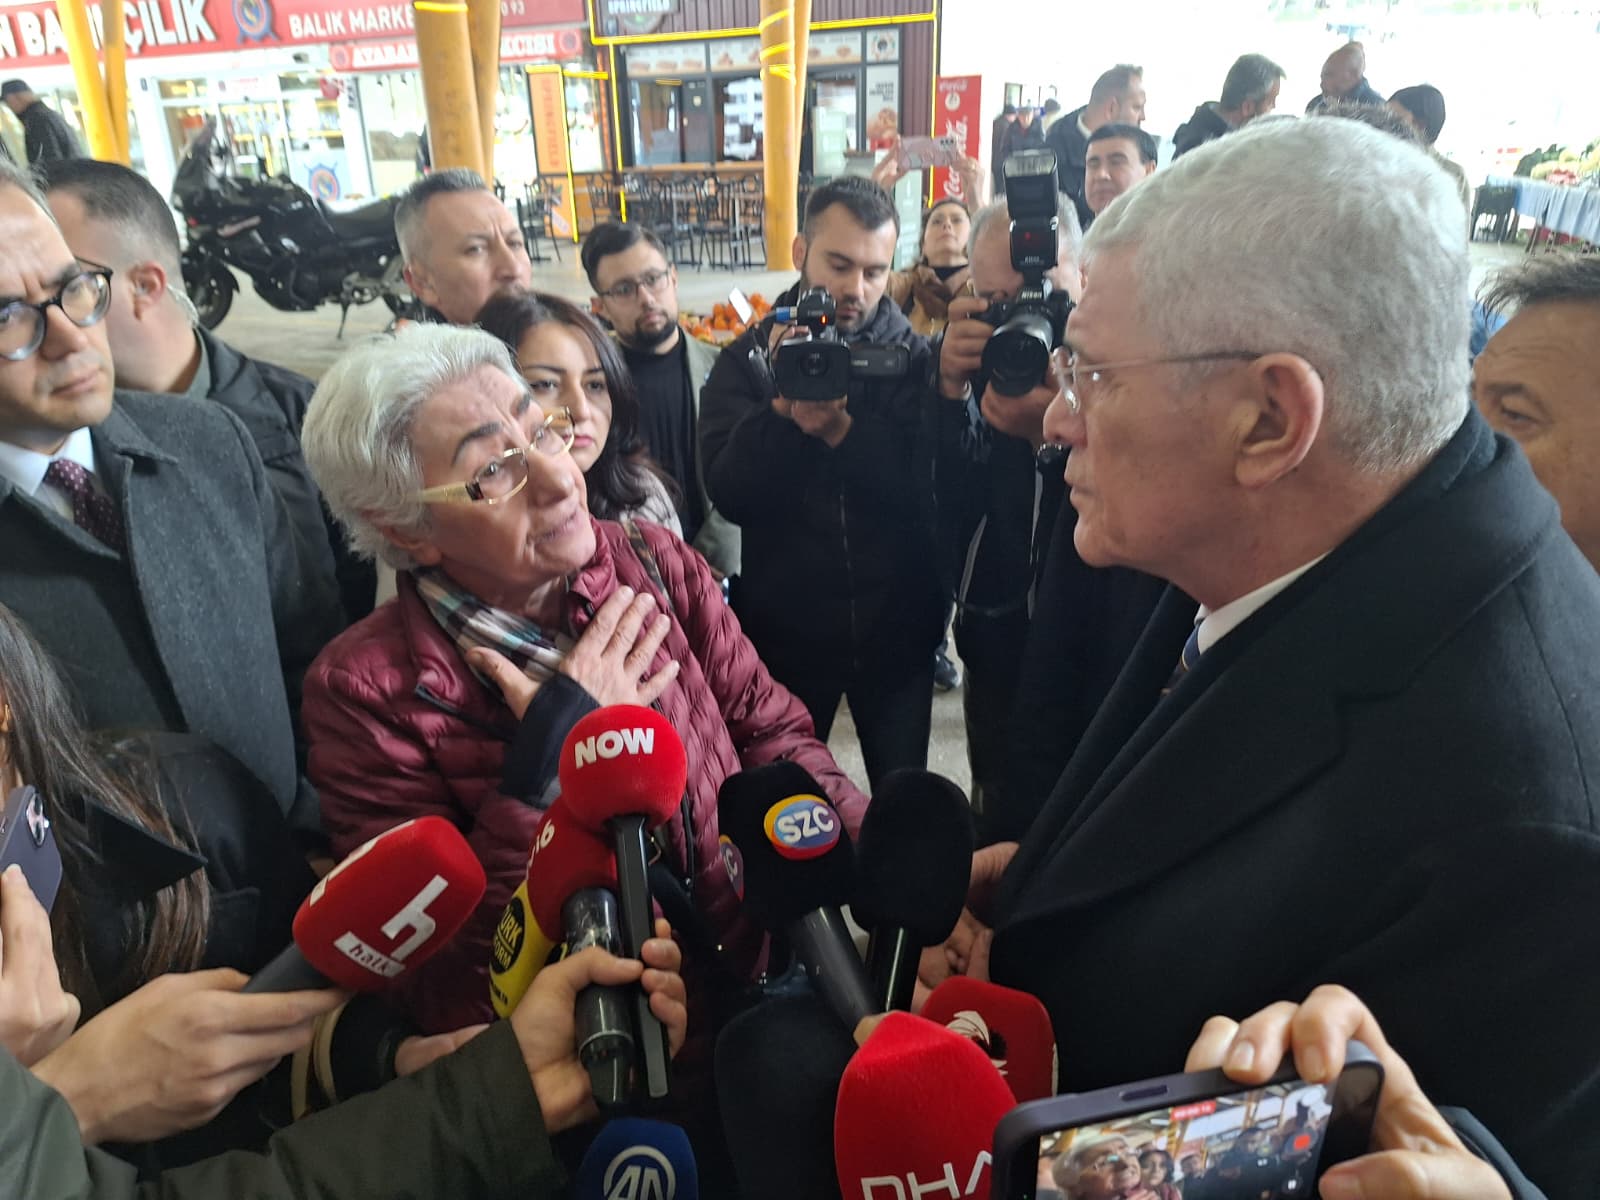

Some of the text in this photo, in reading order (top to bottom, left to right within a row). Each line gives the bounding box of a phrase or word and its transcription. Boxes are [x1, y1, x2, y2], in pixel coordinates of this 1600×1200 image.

[16, 0, 217, 57] BAIÇILIK
[288, 3, 416, 39] BALIK MARKE
[1021, 290, 1042, 300] Nikon
[574, 727, 655, 769] NOW
[776, 805, 835, 844] SZC
